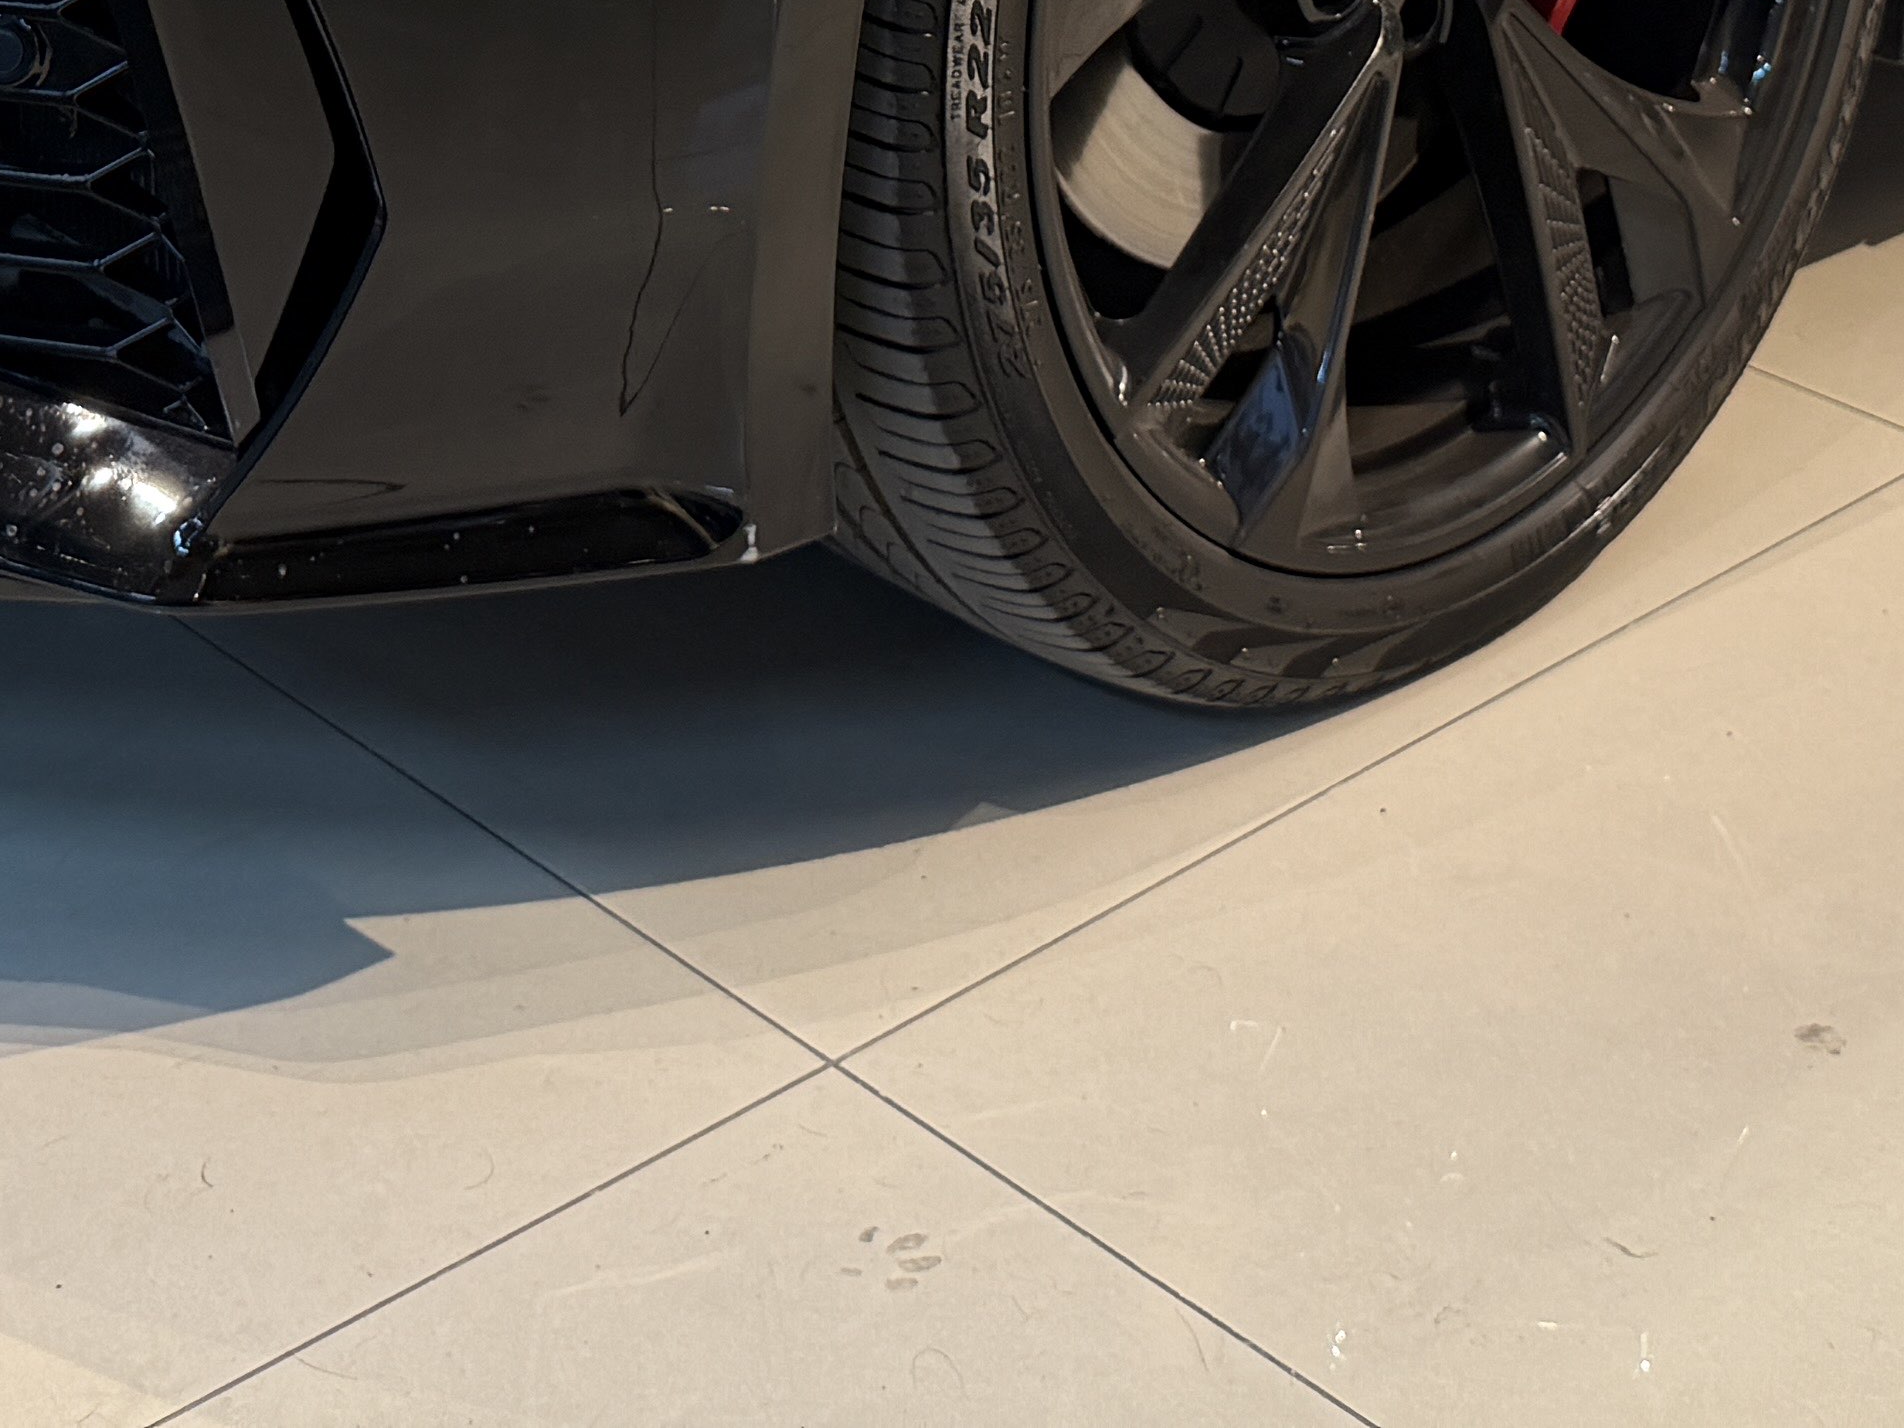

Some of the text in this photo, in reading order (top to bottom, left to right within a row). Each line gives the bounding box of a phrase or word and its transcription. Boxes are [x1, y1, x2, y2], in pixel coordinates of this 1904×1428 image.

[950, 22, 965, 121] TREADWEAR
[965, 0, 992, 140] R22
[966, 154, 1032, 379] 275/35
